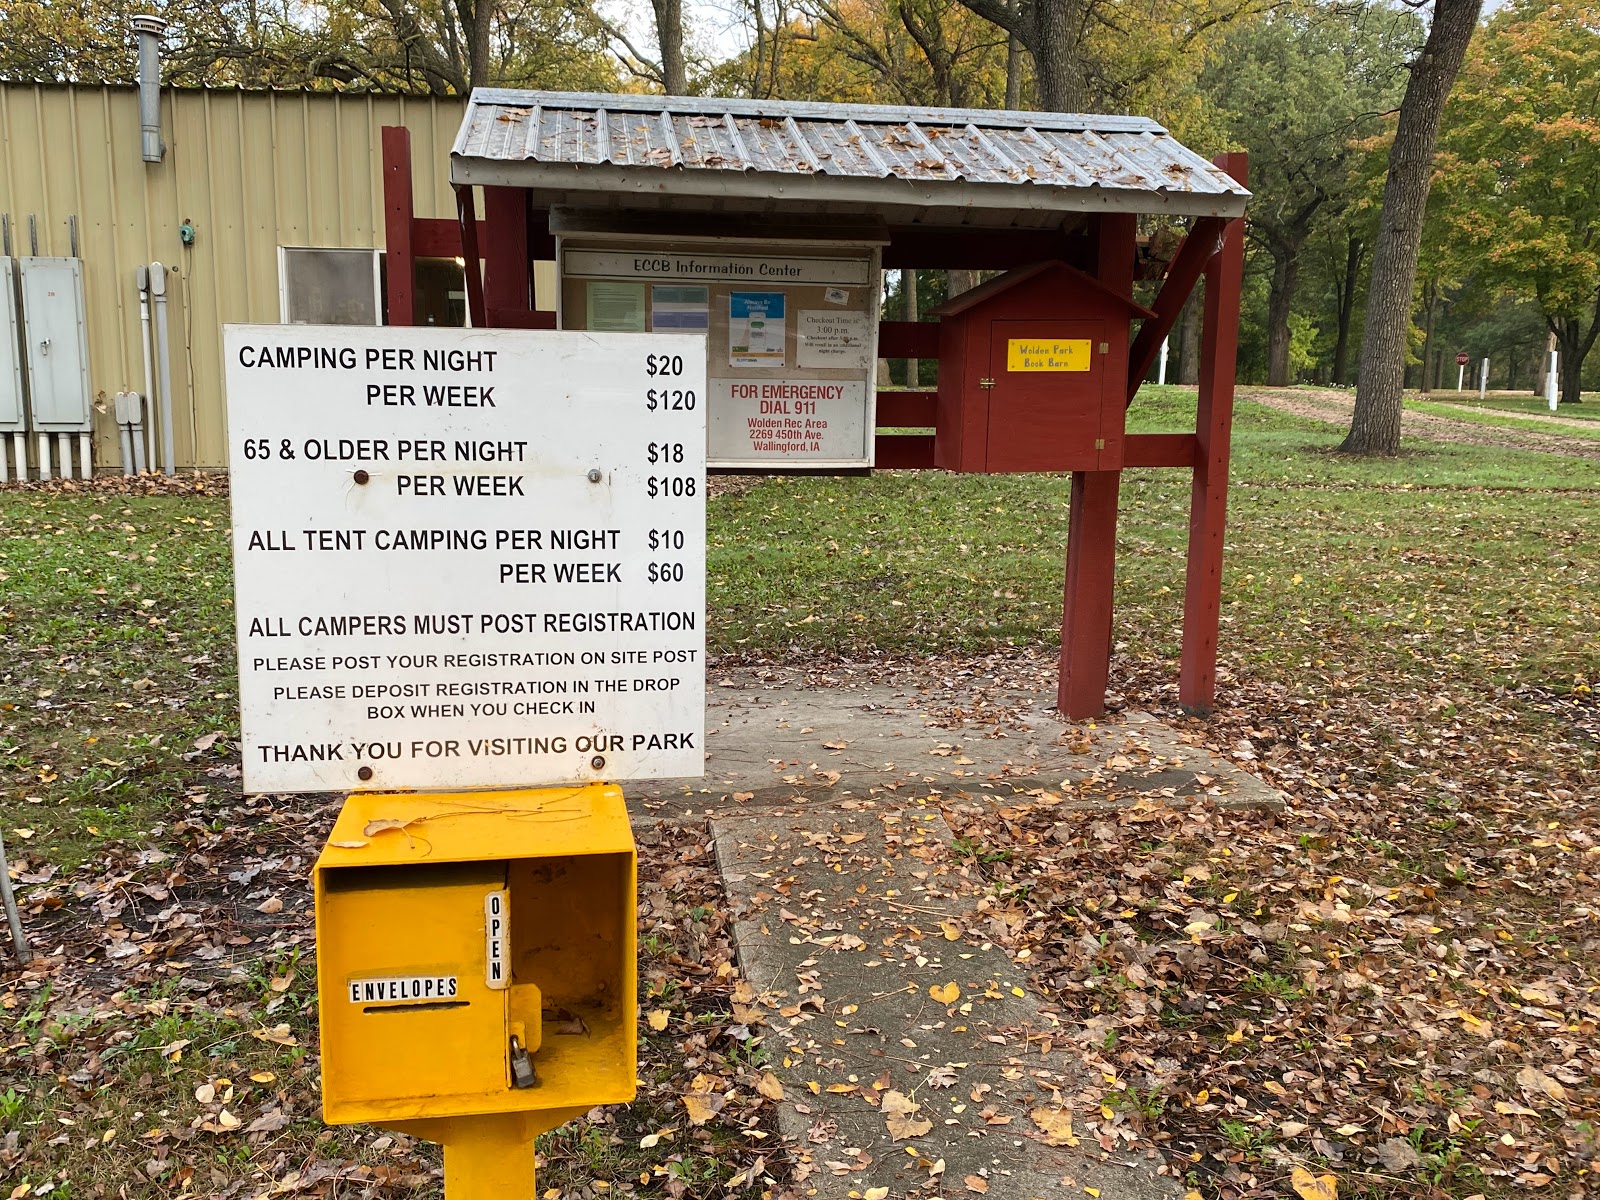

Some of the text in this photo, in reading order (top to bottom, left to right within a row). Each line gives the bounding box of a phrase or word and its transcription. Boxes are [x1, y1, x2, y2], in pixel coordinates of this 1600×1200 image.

[634, 258, 803, 276] ECCB Information Center
[806, 316, 835, 324] Checkout
[816, 326, 850, 335] 3:00 p.m.
[1019, 344, 1074, 355] Wolden Park
[239, 345, 683, 378] CAMPING PER NIGHT $20
[1024, 357, 1069, 368] Book Barn
[366, 384, 696, 413] PER WEEK $120
[731, 384, 844, 400] FOR EMERGENCY
[760, 400, 816, 415] DIAL 911
[747, 418, 828, 429] Wolden Rec Area
[749, 429, 824, 440] 2269 450th Ave.
[244, 438, 684, 466] 65 & OLDER PER NIGHT $18
[753, 441, 820, 453] Wallingford, IA
[397, 475, 696, 500] PER WEEK $108
[248, 528, 684, 552] ALL TENT CAMPING PER NIGHT $10
[500, 561, 684, 585] PER WEEK $60
[249, 611, 695, 637] ALL CAMPERS MUST POST REGISTRATION
[253, 649, 698, 671] PLEASE POST YOUR REGISTRATION ON SITE POST
[274, 678, 680, 700] PLEASE DEPOSIT REGISTRATION IN THE DROP
[367, 700, 595, 719] BOX WHEN YOU CHECK IN
[257, 732, 695, 763] THANK YOU FOR VISITING OUR PARK
[491, 896, 501, 980] OPEN
[352, 977, 457, 1002] ENVELOPES
